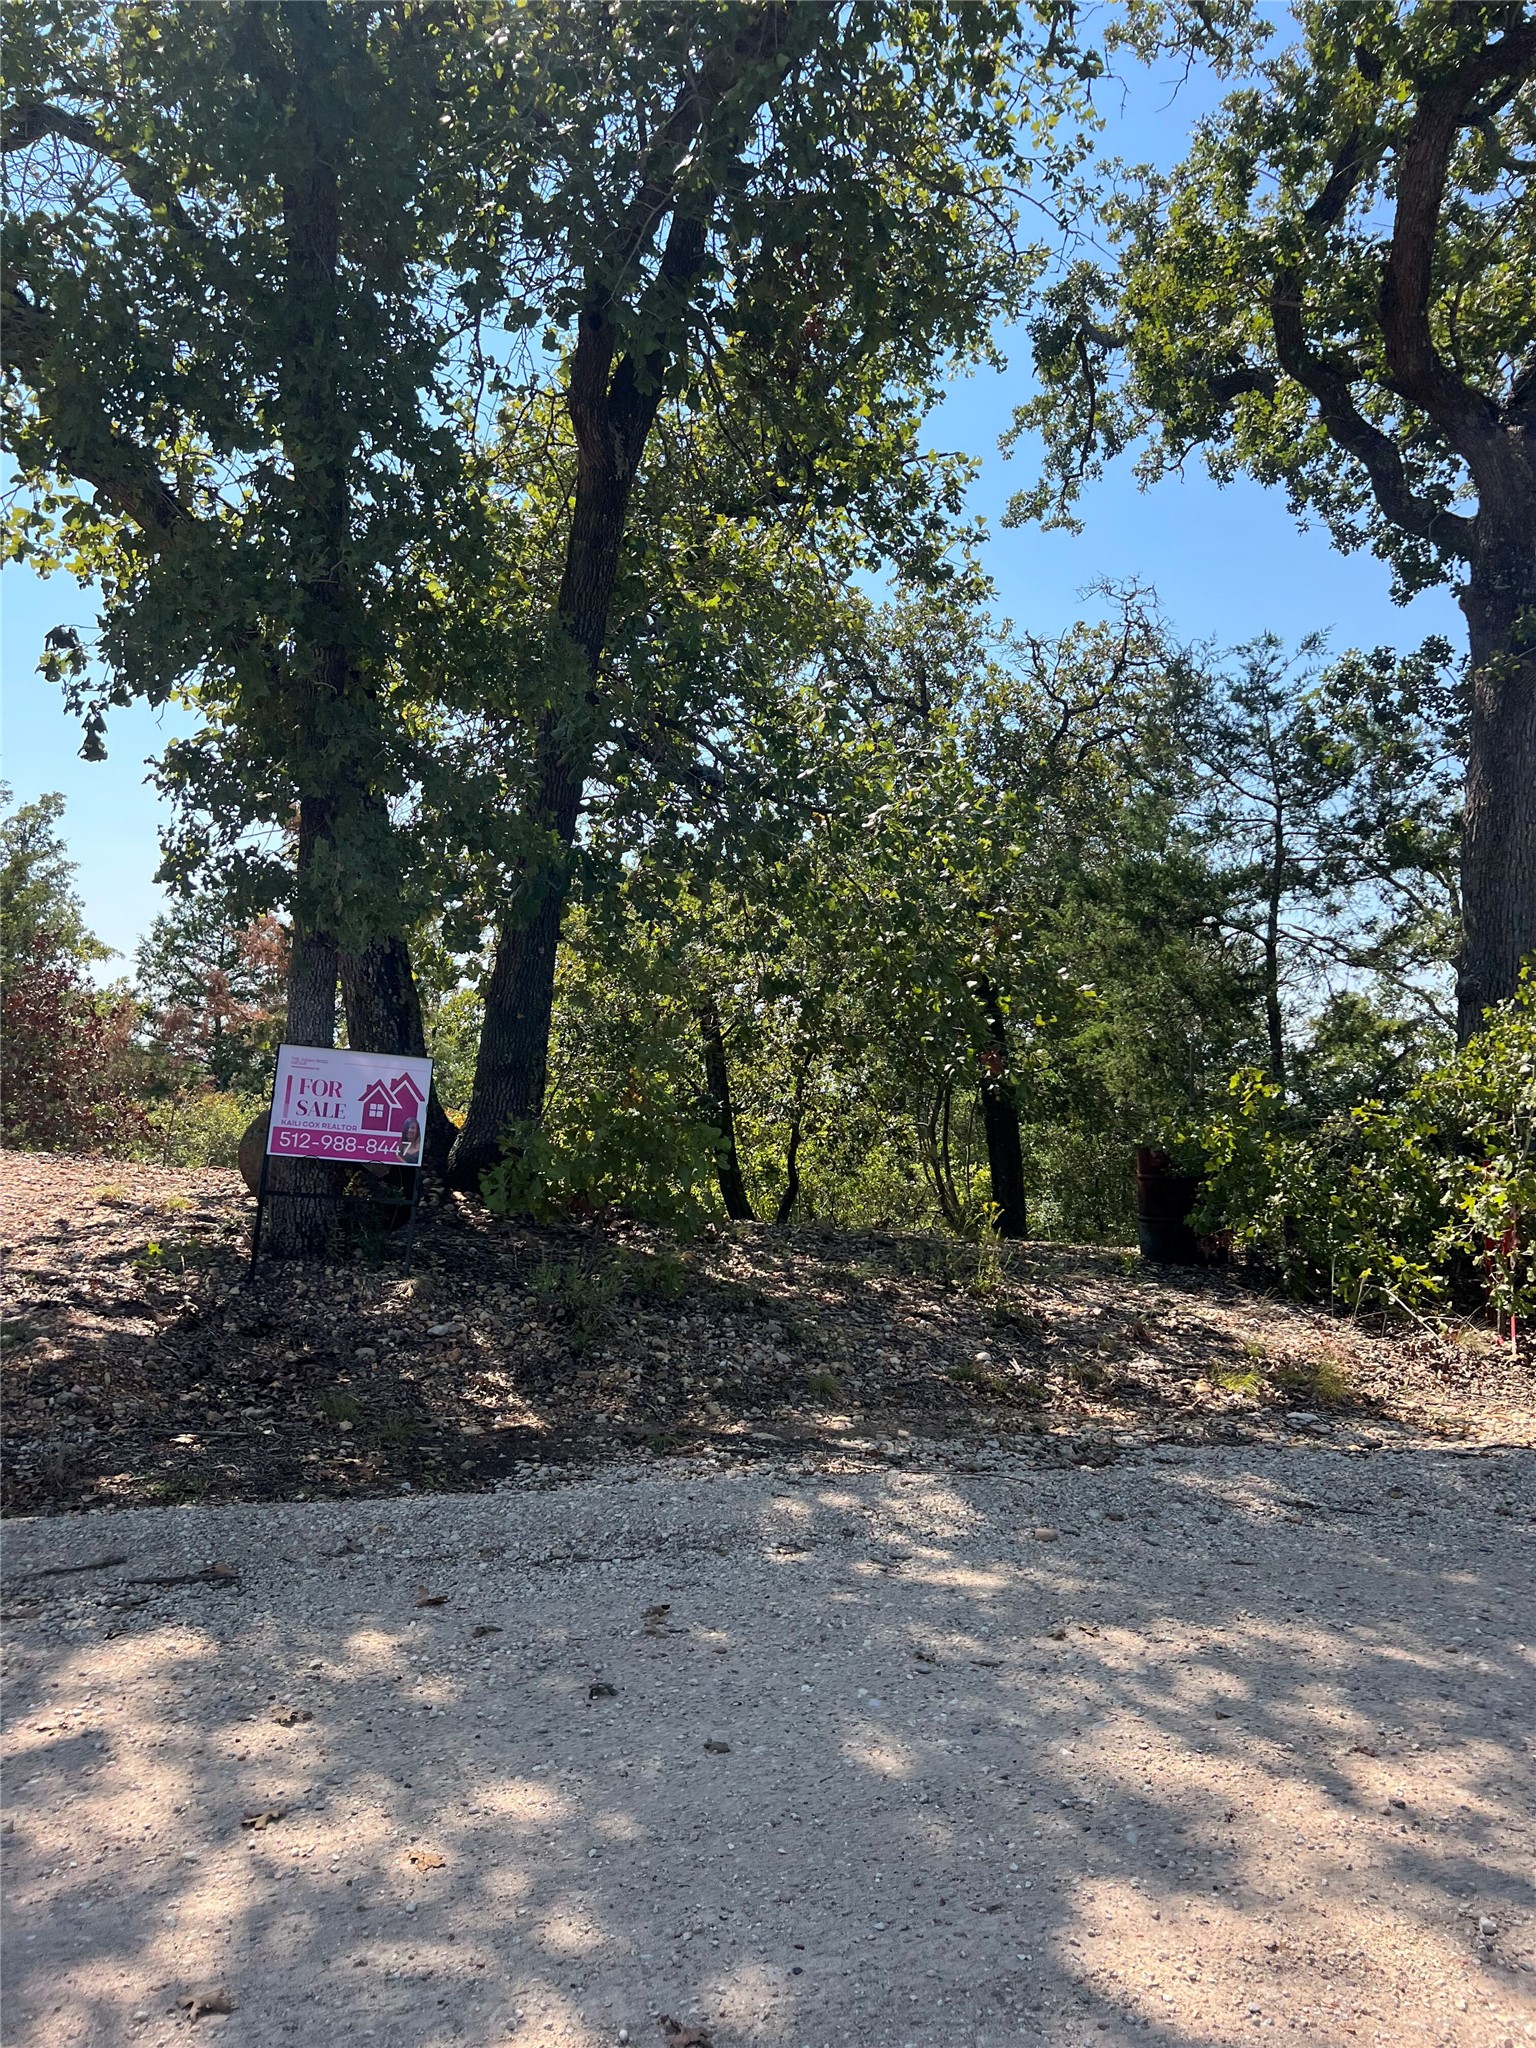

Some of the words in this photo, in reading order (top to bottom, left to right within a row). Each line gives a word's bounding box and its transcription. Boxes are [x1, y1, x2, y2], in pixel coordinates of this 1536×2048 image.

[299, 1077, 343, 1099] FOR
[295, 1099, 347, 1120] SALE
[280, 1119, 302, 1127] KAILI
[302, 1120, 321, 1129] COX
[321, 1122, 358, 1132] REALTOR
[279, 1131, 413, 1157] 512-988-8447
